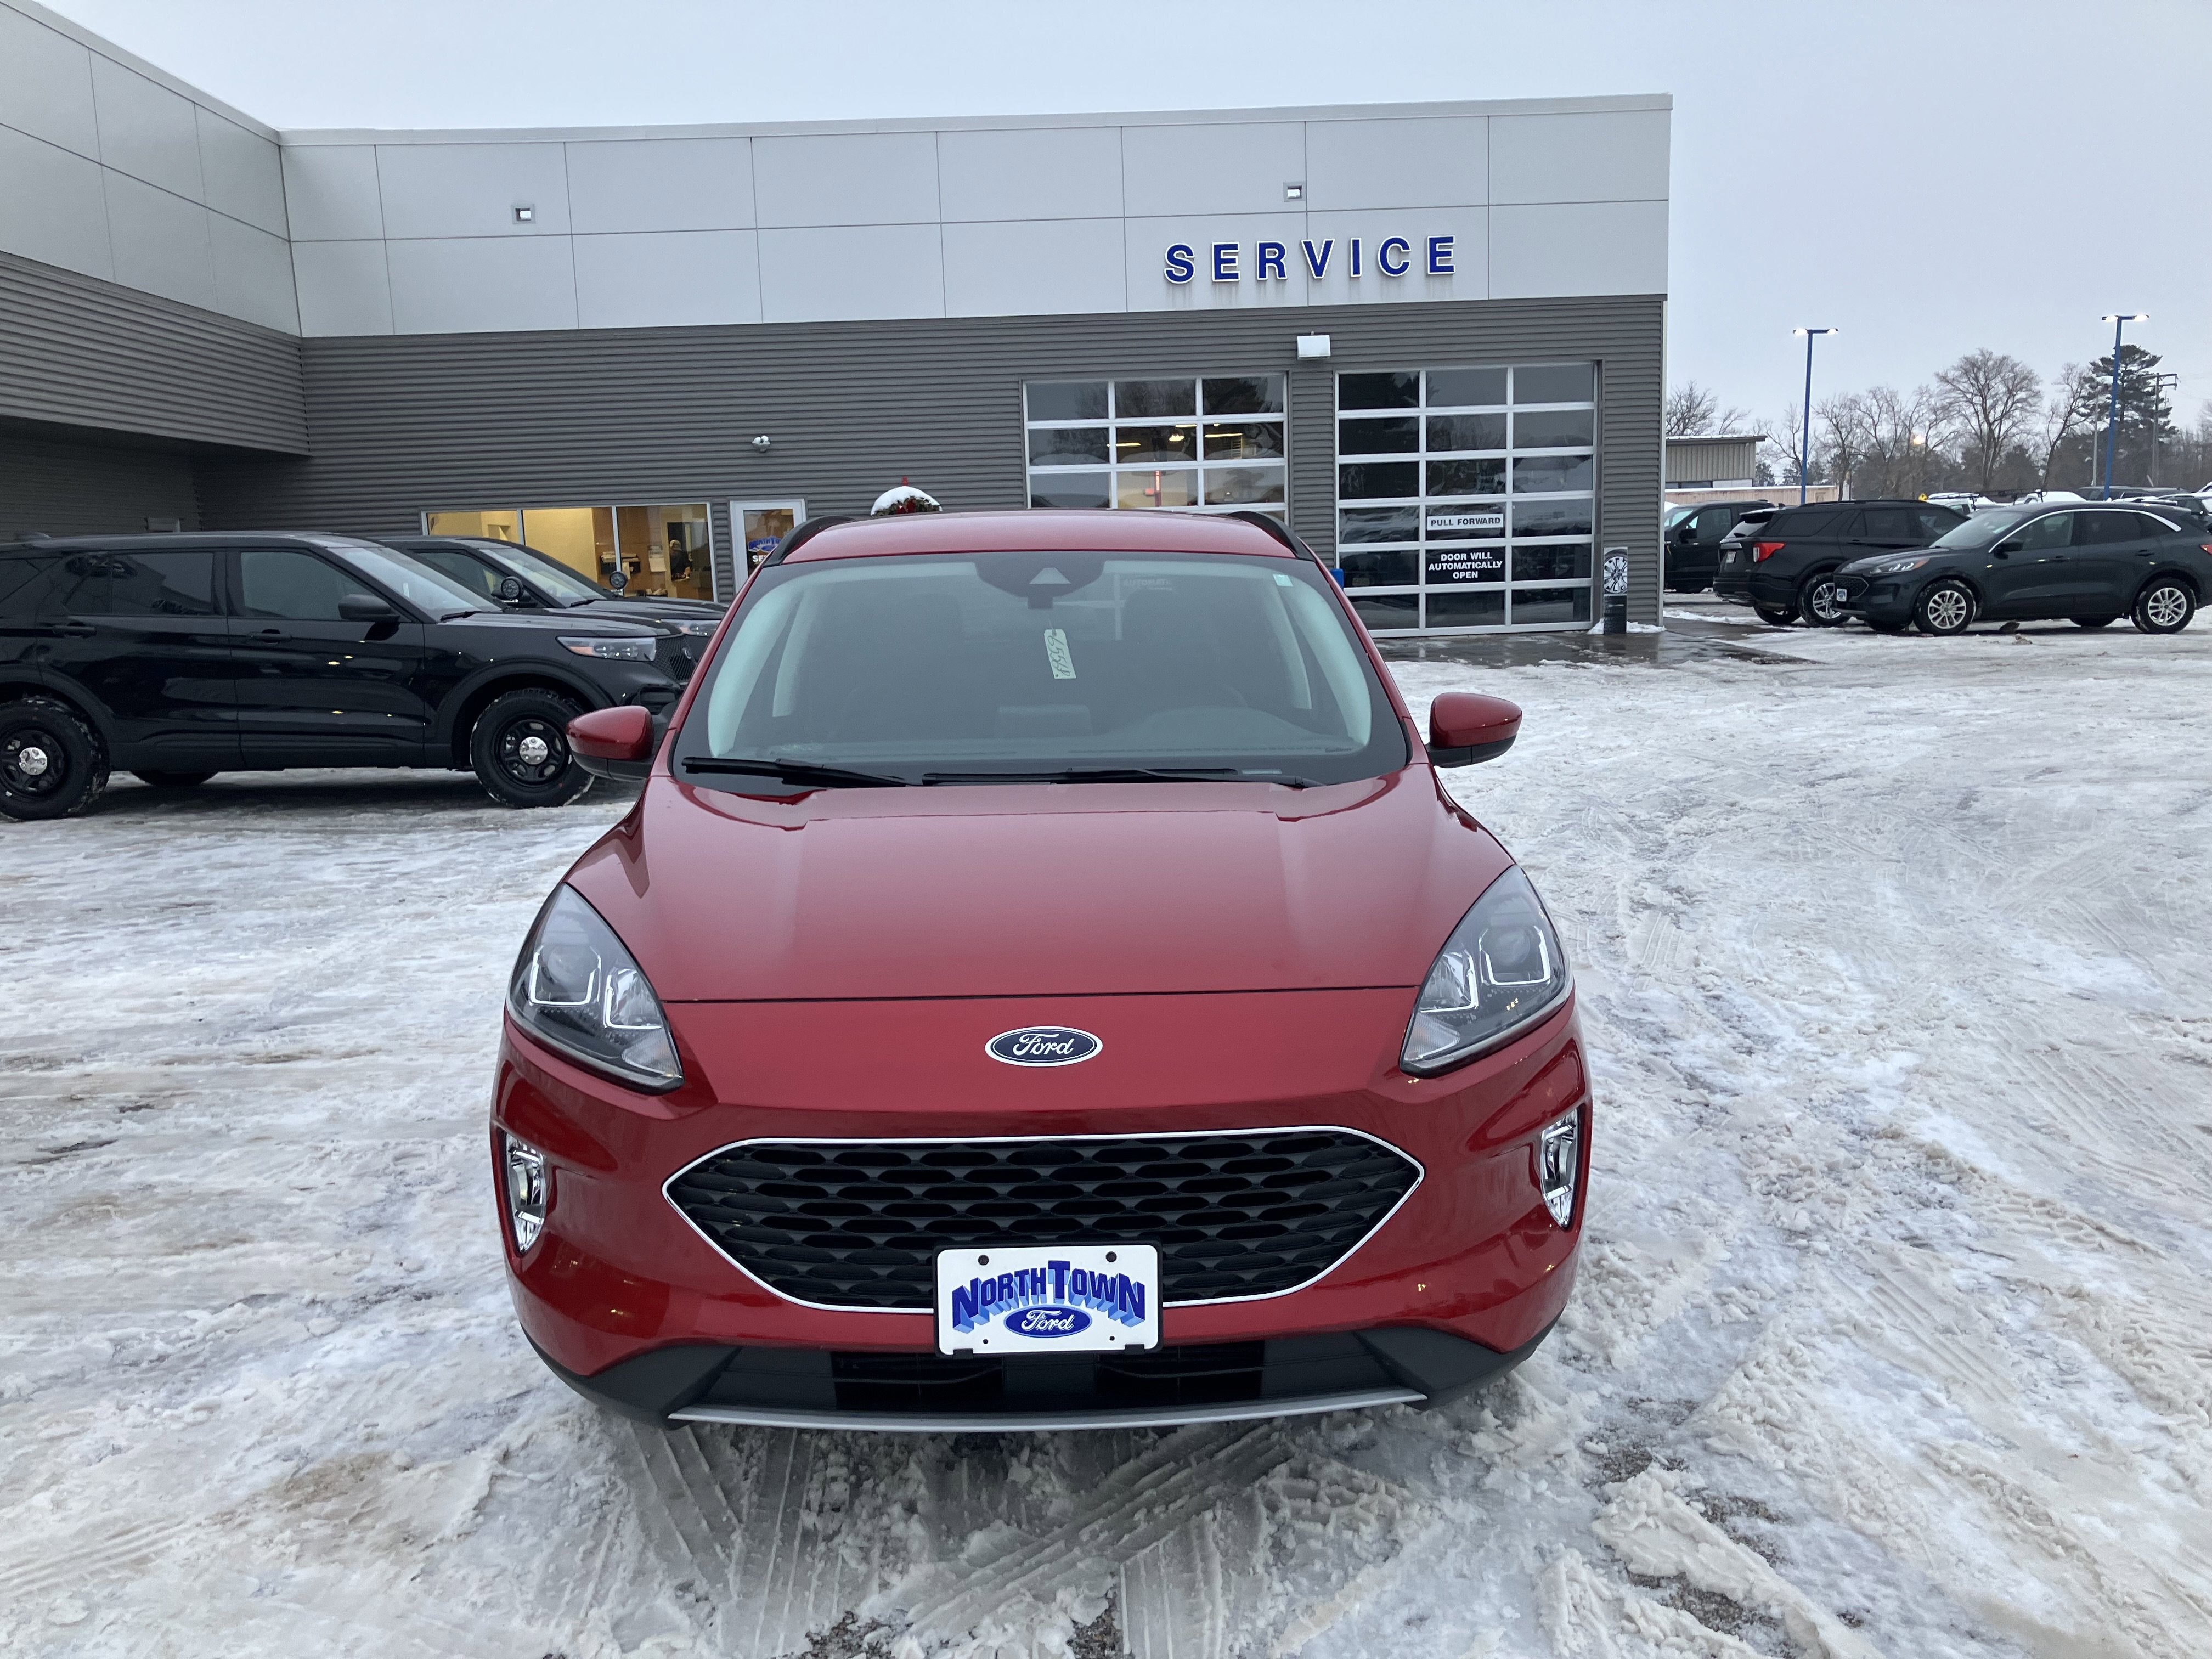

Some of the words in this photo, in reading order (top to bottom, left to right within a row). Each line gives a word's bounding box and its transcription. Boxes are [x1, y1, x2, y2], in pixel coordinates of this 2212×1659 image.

[1164, 235, 1455, 284] SERVICE
[1457, 517, 1500, 526] FORWARD
[1441, 553, 1467, 561] DOOR
[1428, 561, 1503, 571] AUTOMATICALLY
[1453, 571, 1479, 579] OPEN
[1013, 1033, 1075, 1056] Ford
[1021, 1310, 1074, 1331] Ford
